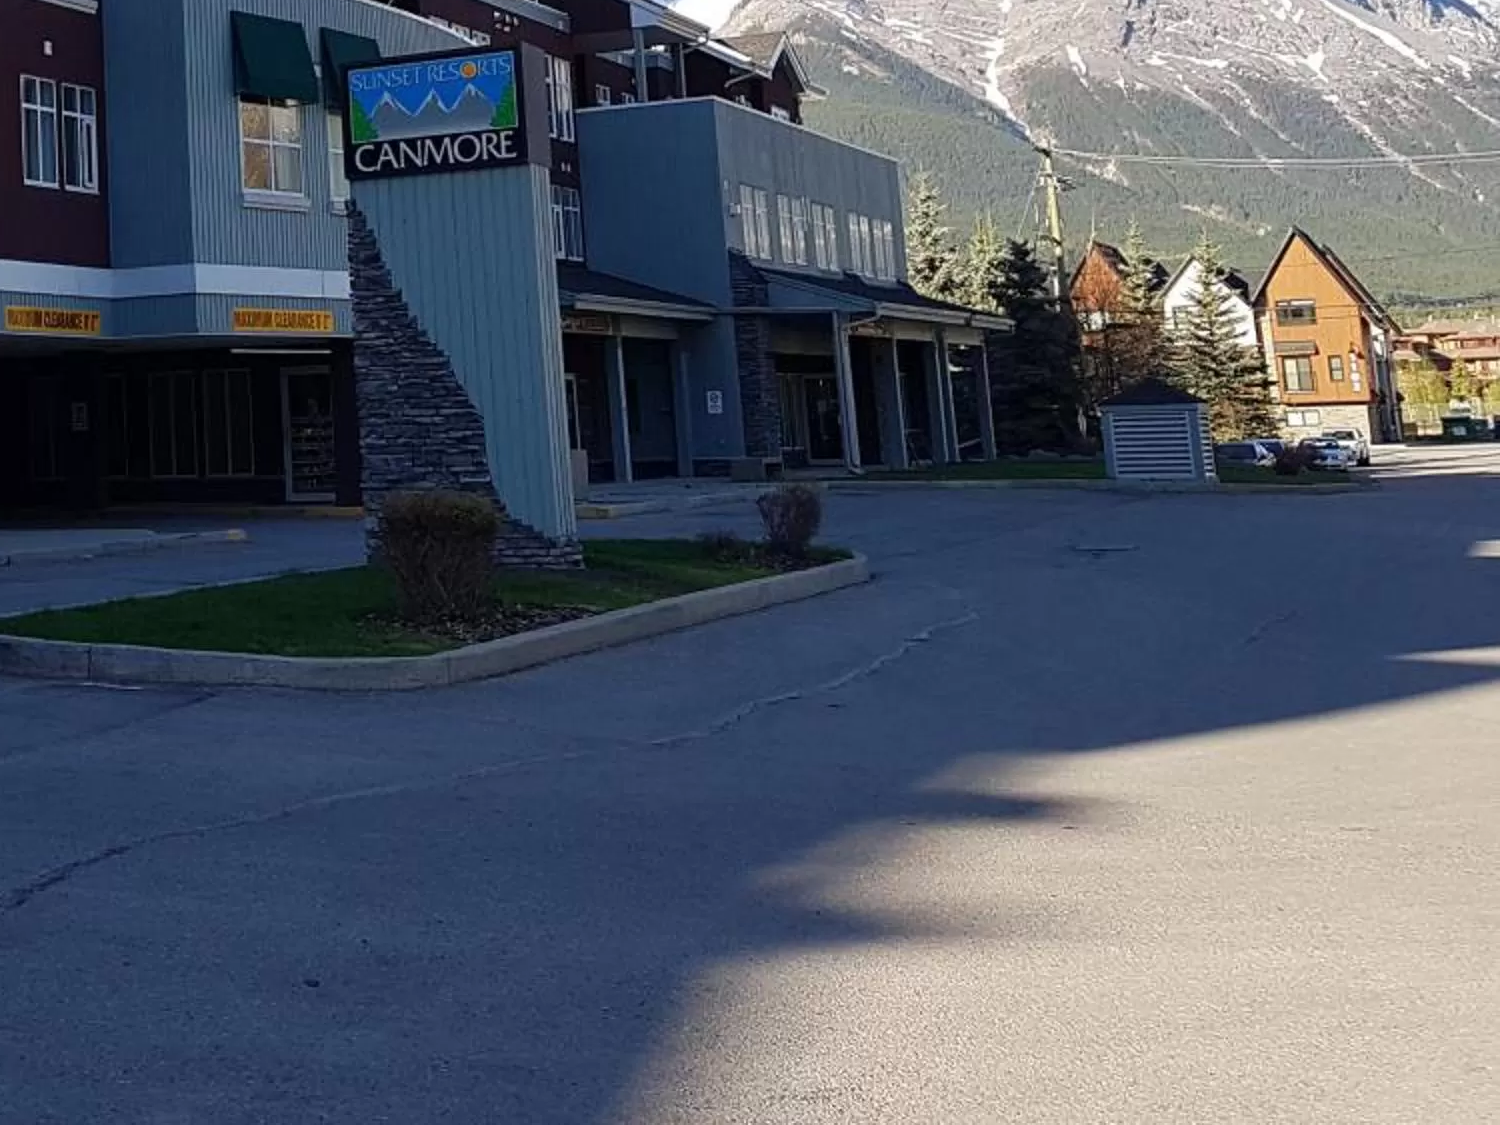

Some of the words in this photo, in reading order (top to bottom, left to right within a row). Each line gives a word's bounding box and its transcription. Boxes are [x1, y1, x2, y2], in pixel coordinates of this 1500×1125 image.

[350, 64, 424, 92] SUNSET
[426, 55, 511, 84] RESORTS
[354, 130, 518, 173] CANMORE
